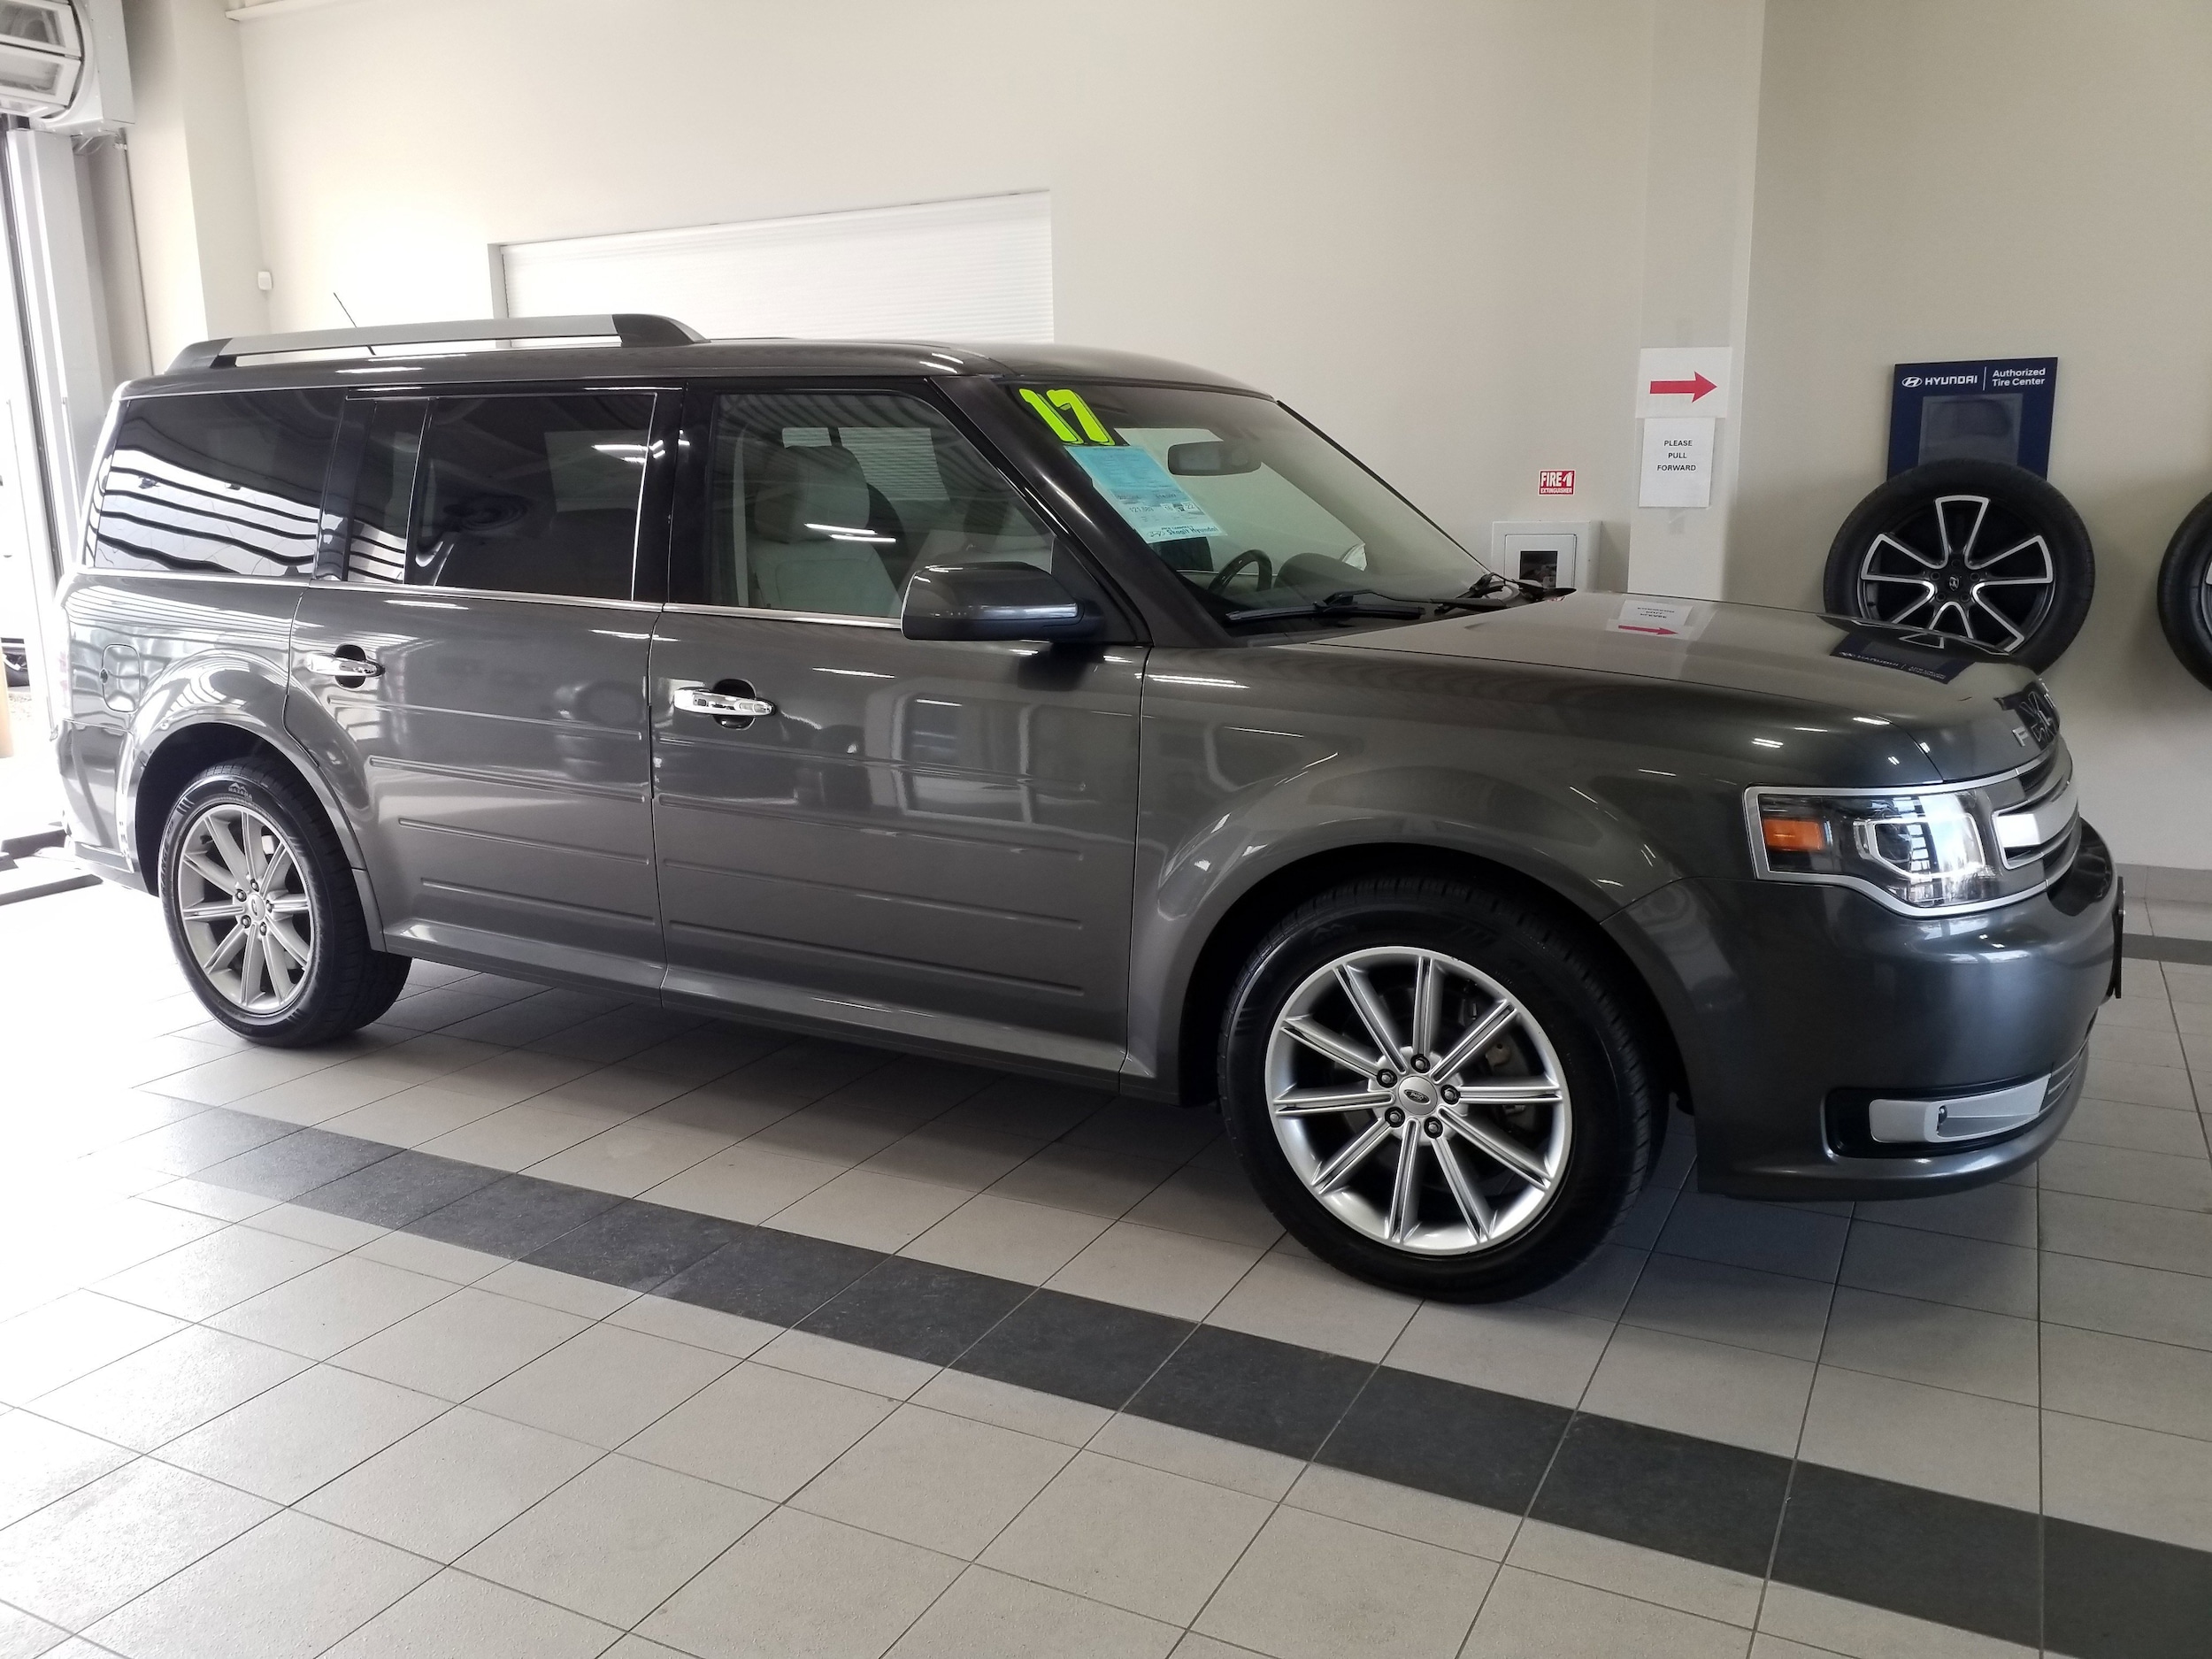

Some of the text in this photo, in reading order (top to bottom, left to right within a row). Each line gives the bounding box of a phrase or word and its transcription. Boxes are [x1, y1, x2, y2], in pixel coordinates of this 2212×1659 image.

[1993, 368, 2046, 379] Authorized
[1924, 375, 1978, 386] HYUNDAI
[1992, 377, 2046, 388] Tire Center
[1019, 388, 1115, 446] 17
[1540, 472, 1563, 488] FIRE
